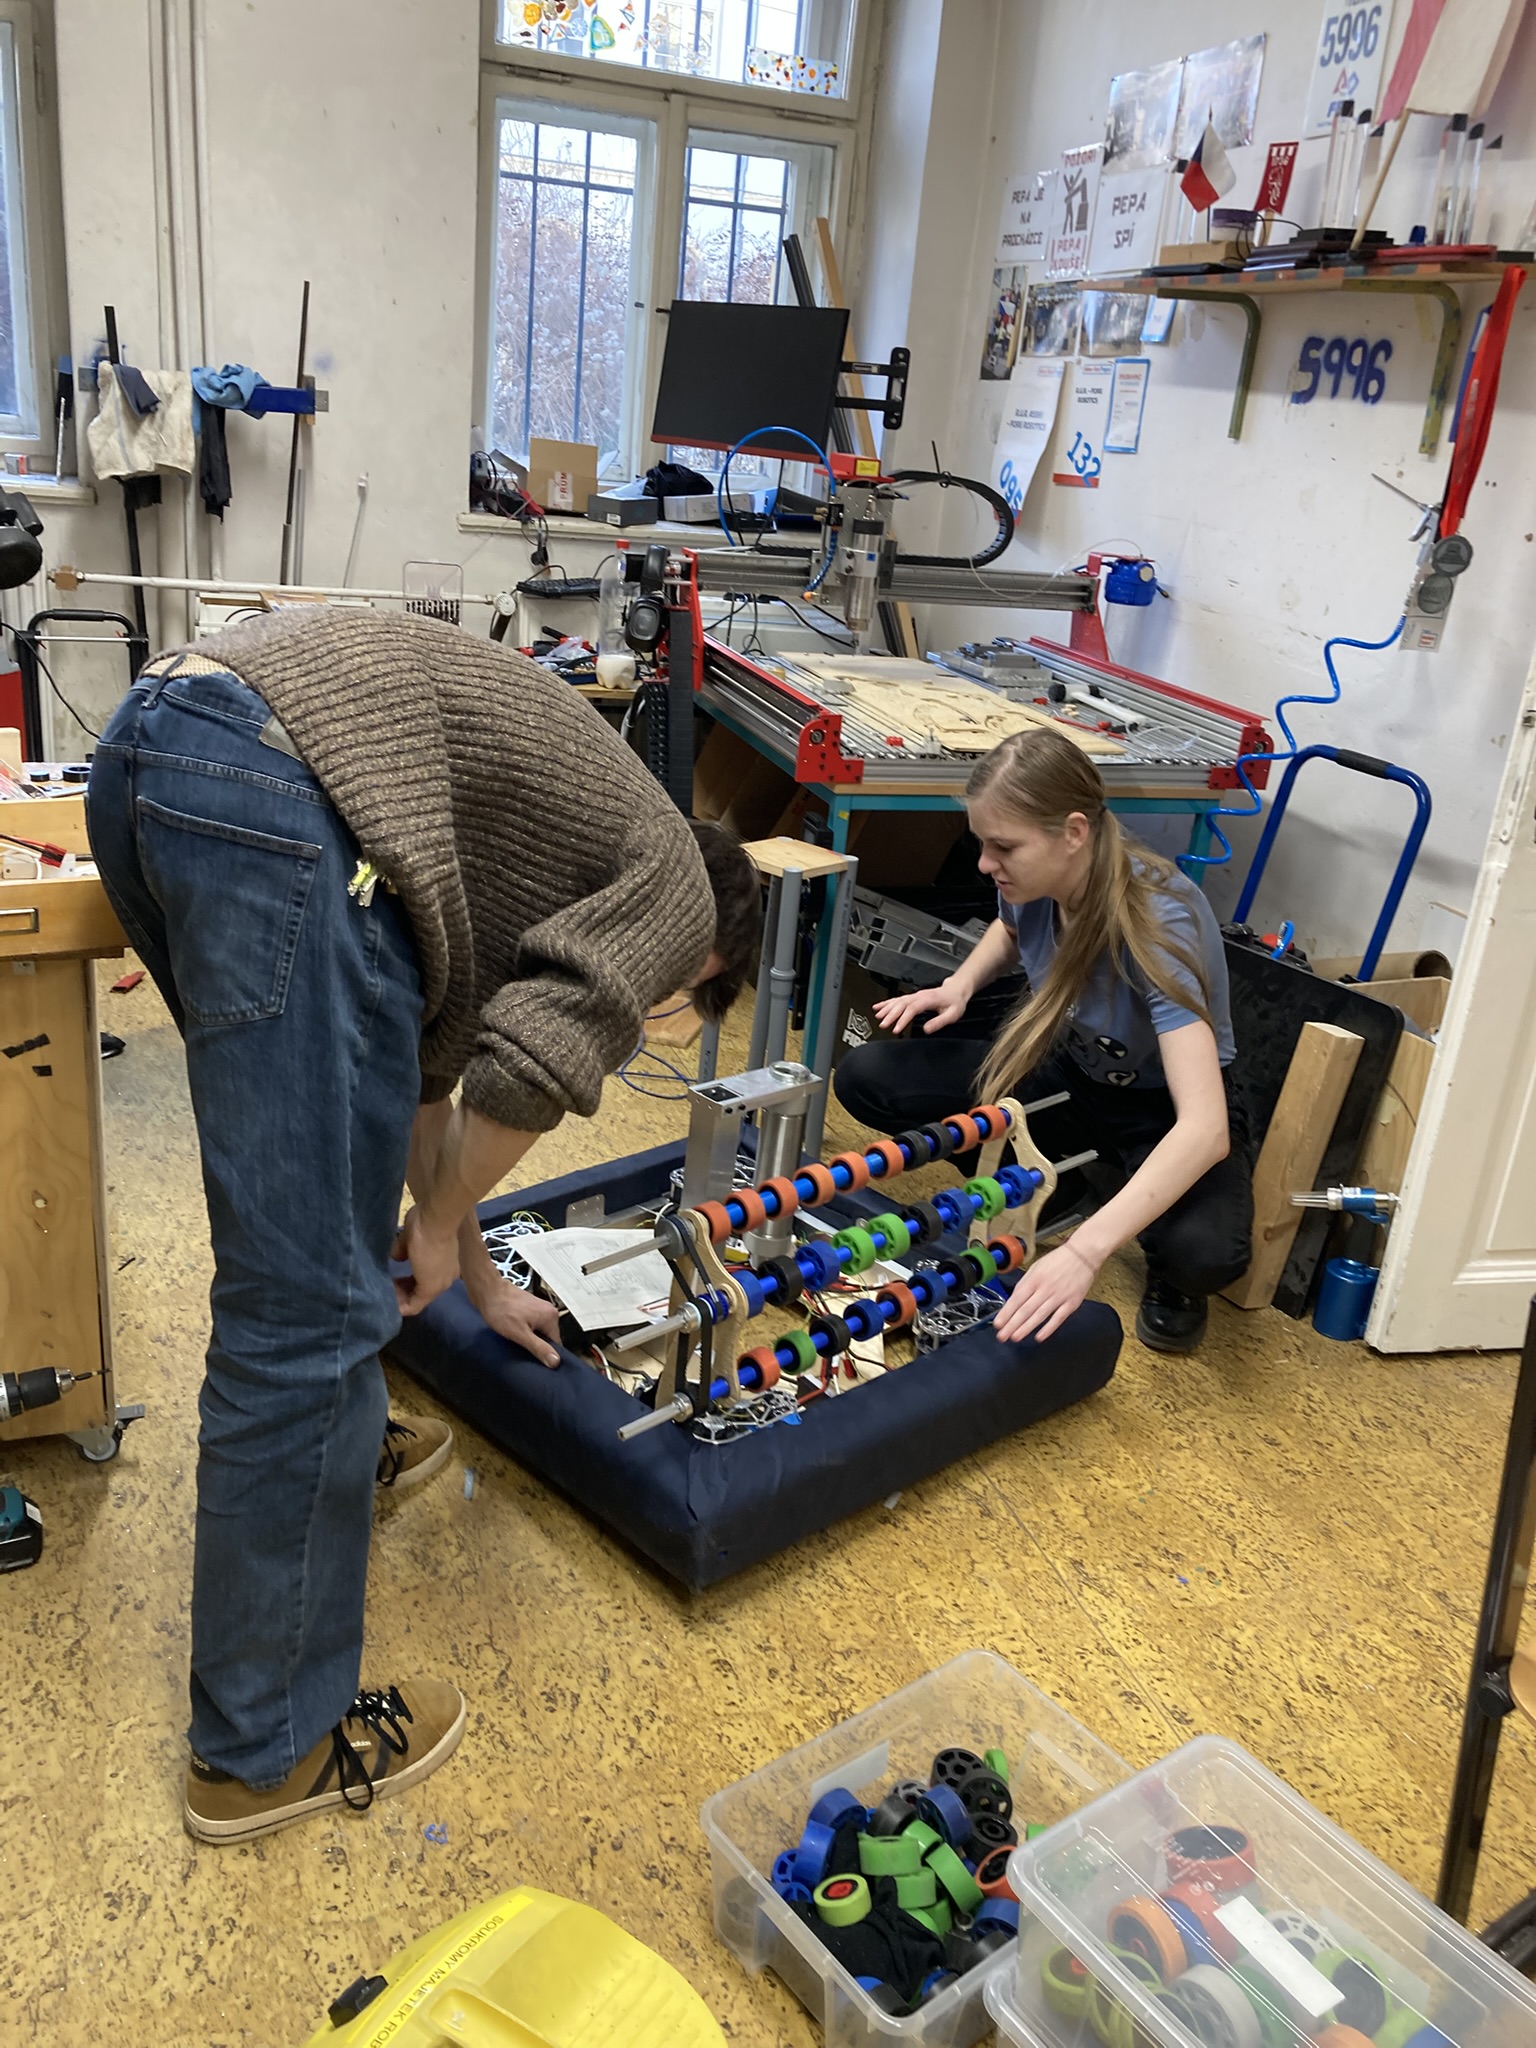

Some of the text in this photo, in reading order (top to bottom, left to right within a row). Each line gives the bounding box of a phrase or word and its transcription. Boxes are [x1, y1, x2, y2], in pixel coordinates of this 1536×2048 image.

[1320, 5, 1382, 68] 5996
[1011, 187, 1045, 204] PEPA JE
[1112, 192, 1147, 216] PEPA
[1019, 211, 1031, 225] NA
[1113, 222, 1136, 249] SPÍ
[1057, 237, 1081, 252] PEPA
[1290, 336, 1393, 405] 5996
[1067, 431, 1101, 488] 132
[444, 1915, 504, 1969] SOUKROMY
[393, 1968, 446, 2021] MAJETEK
